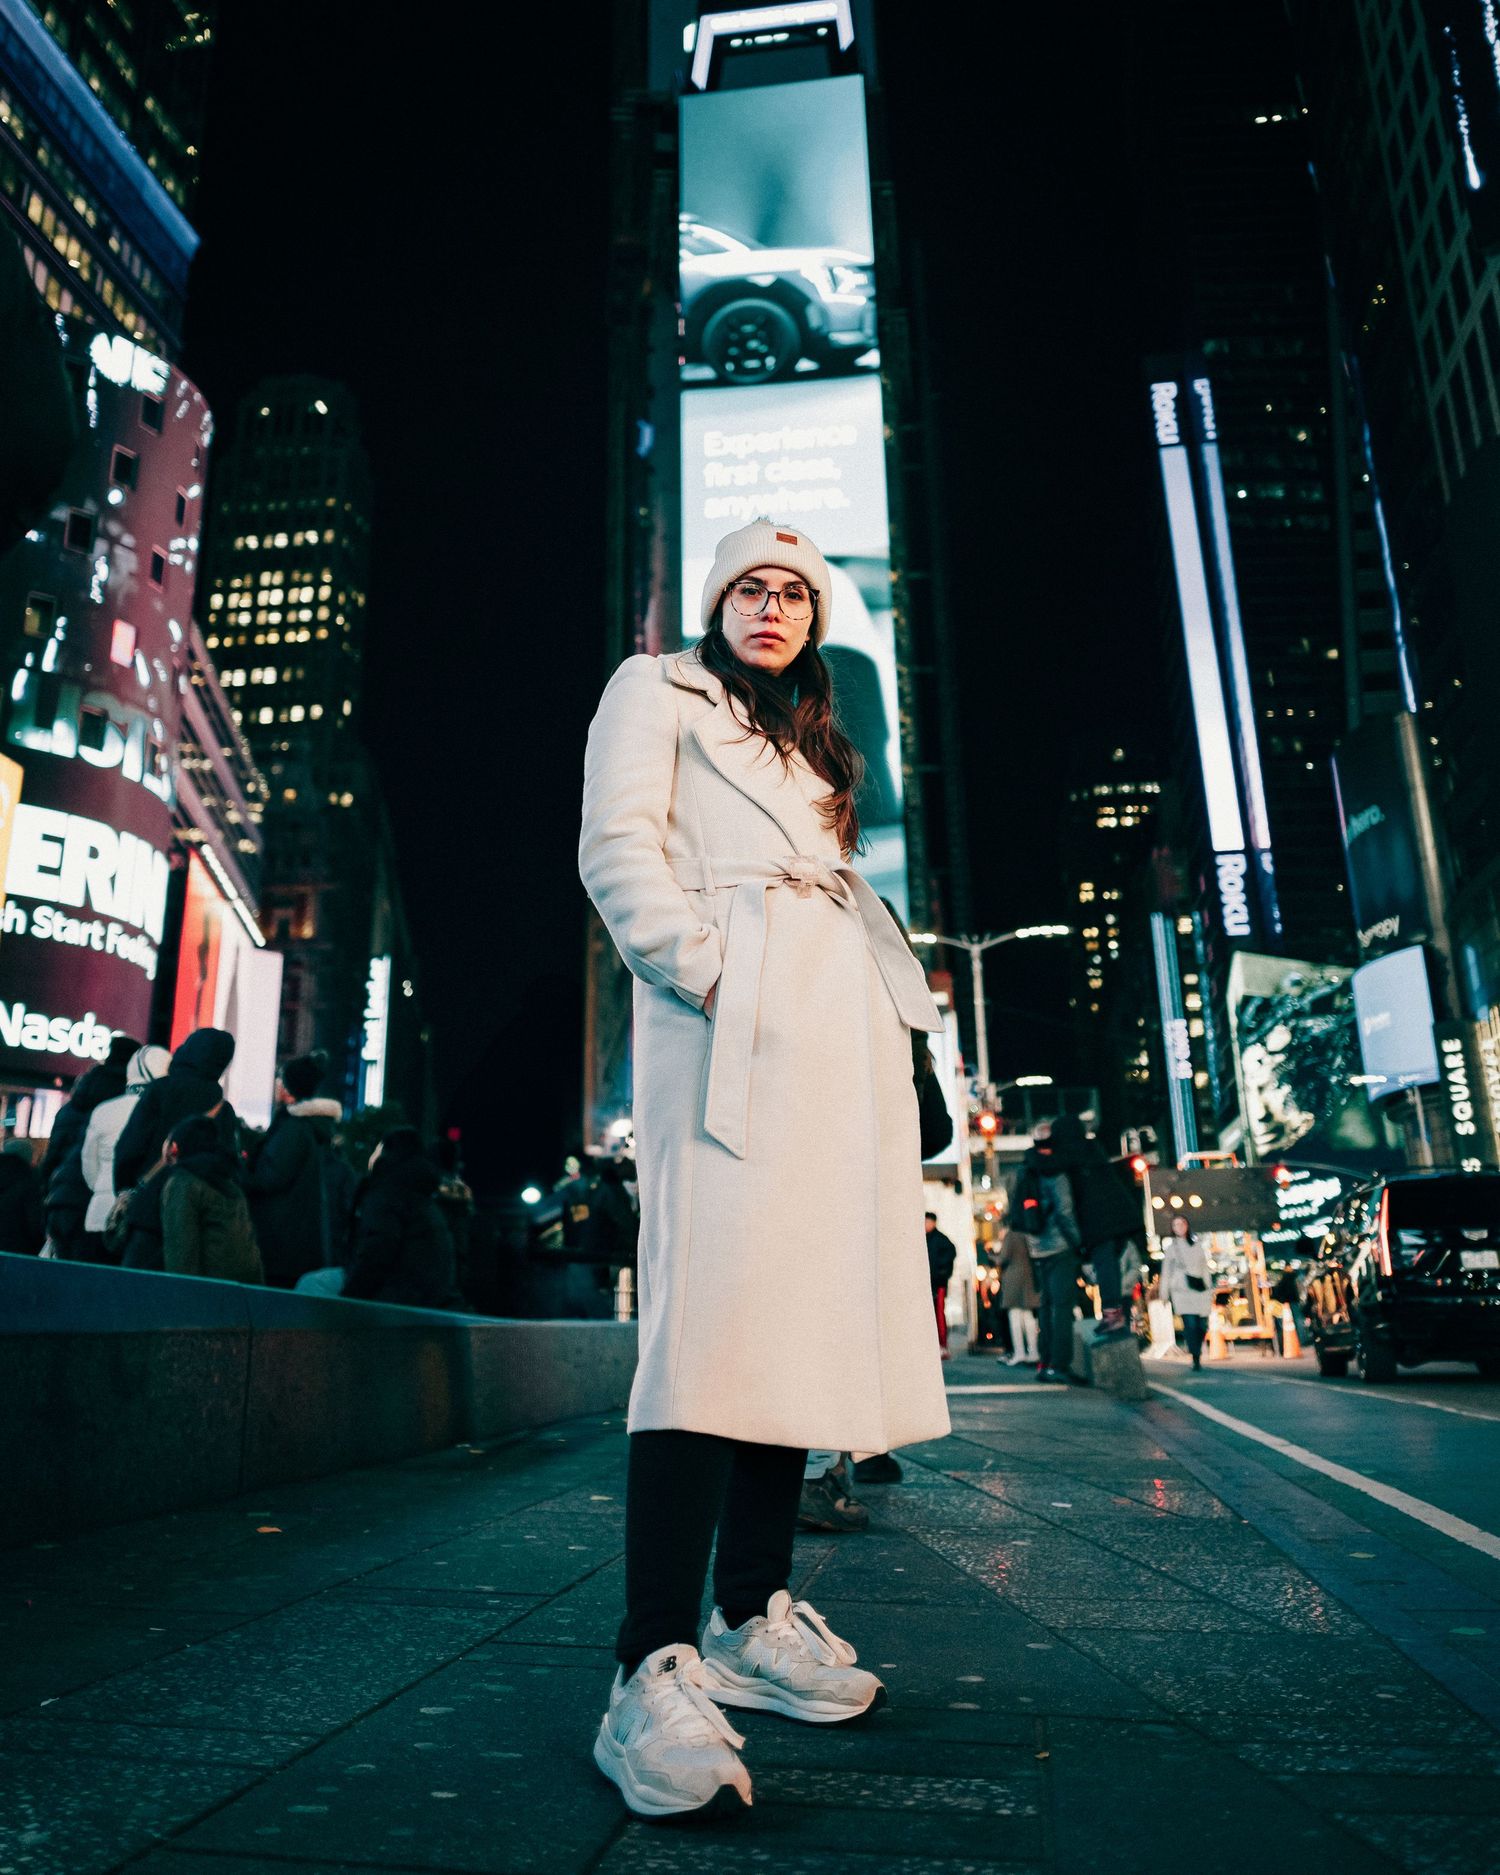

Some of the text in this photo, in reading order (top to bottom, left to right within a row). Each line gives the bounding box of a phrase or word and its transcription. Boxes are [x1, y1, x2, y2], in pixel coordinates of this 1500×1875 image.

[31, 905, 106, 951] Start
[0, 999, 125, 1064] Nasda
[1441, 1038, 1477, 1136] SQUARE
